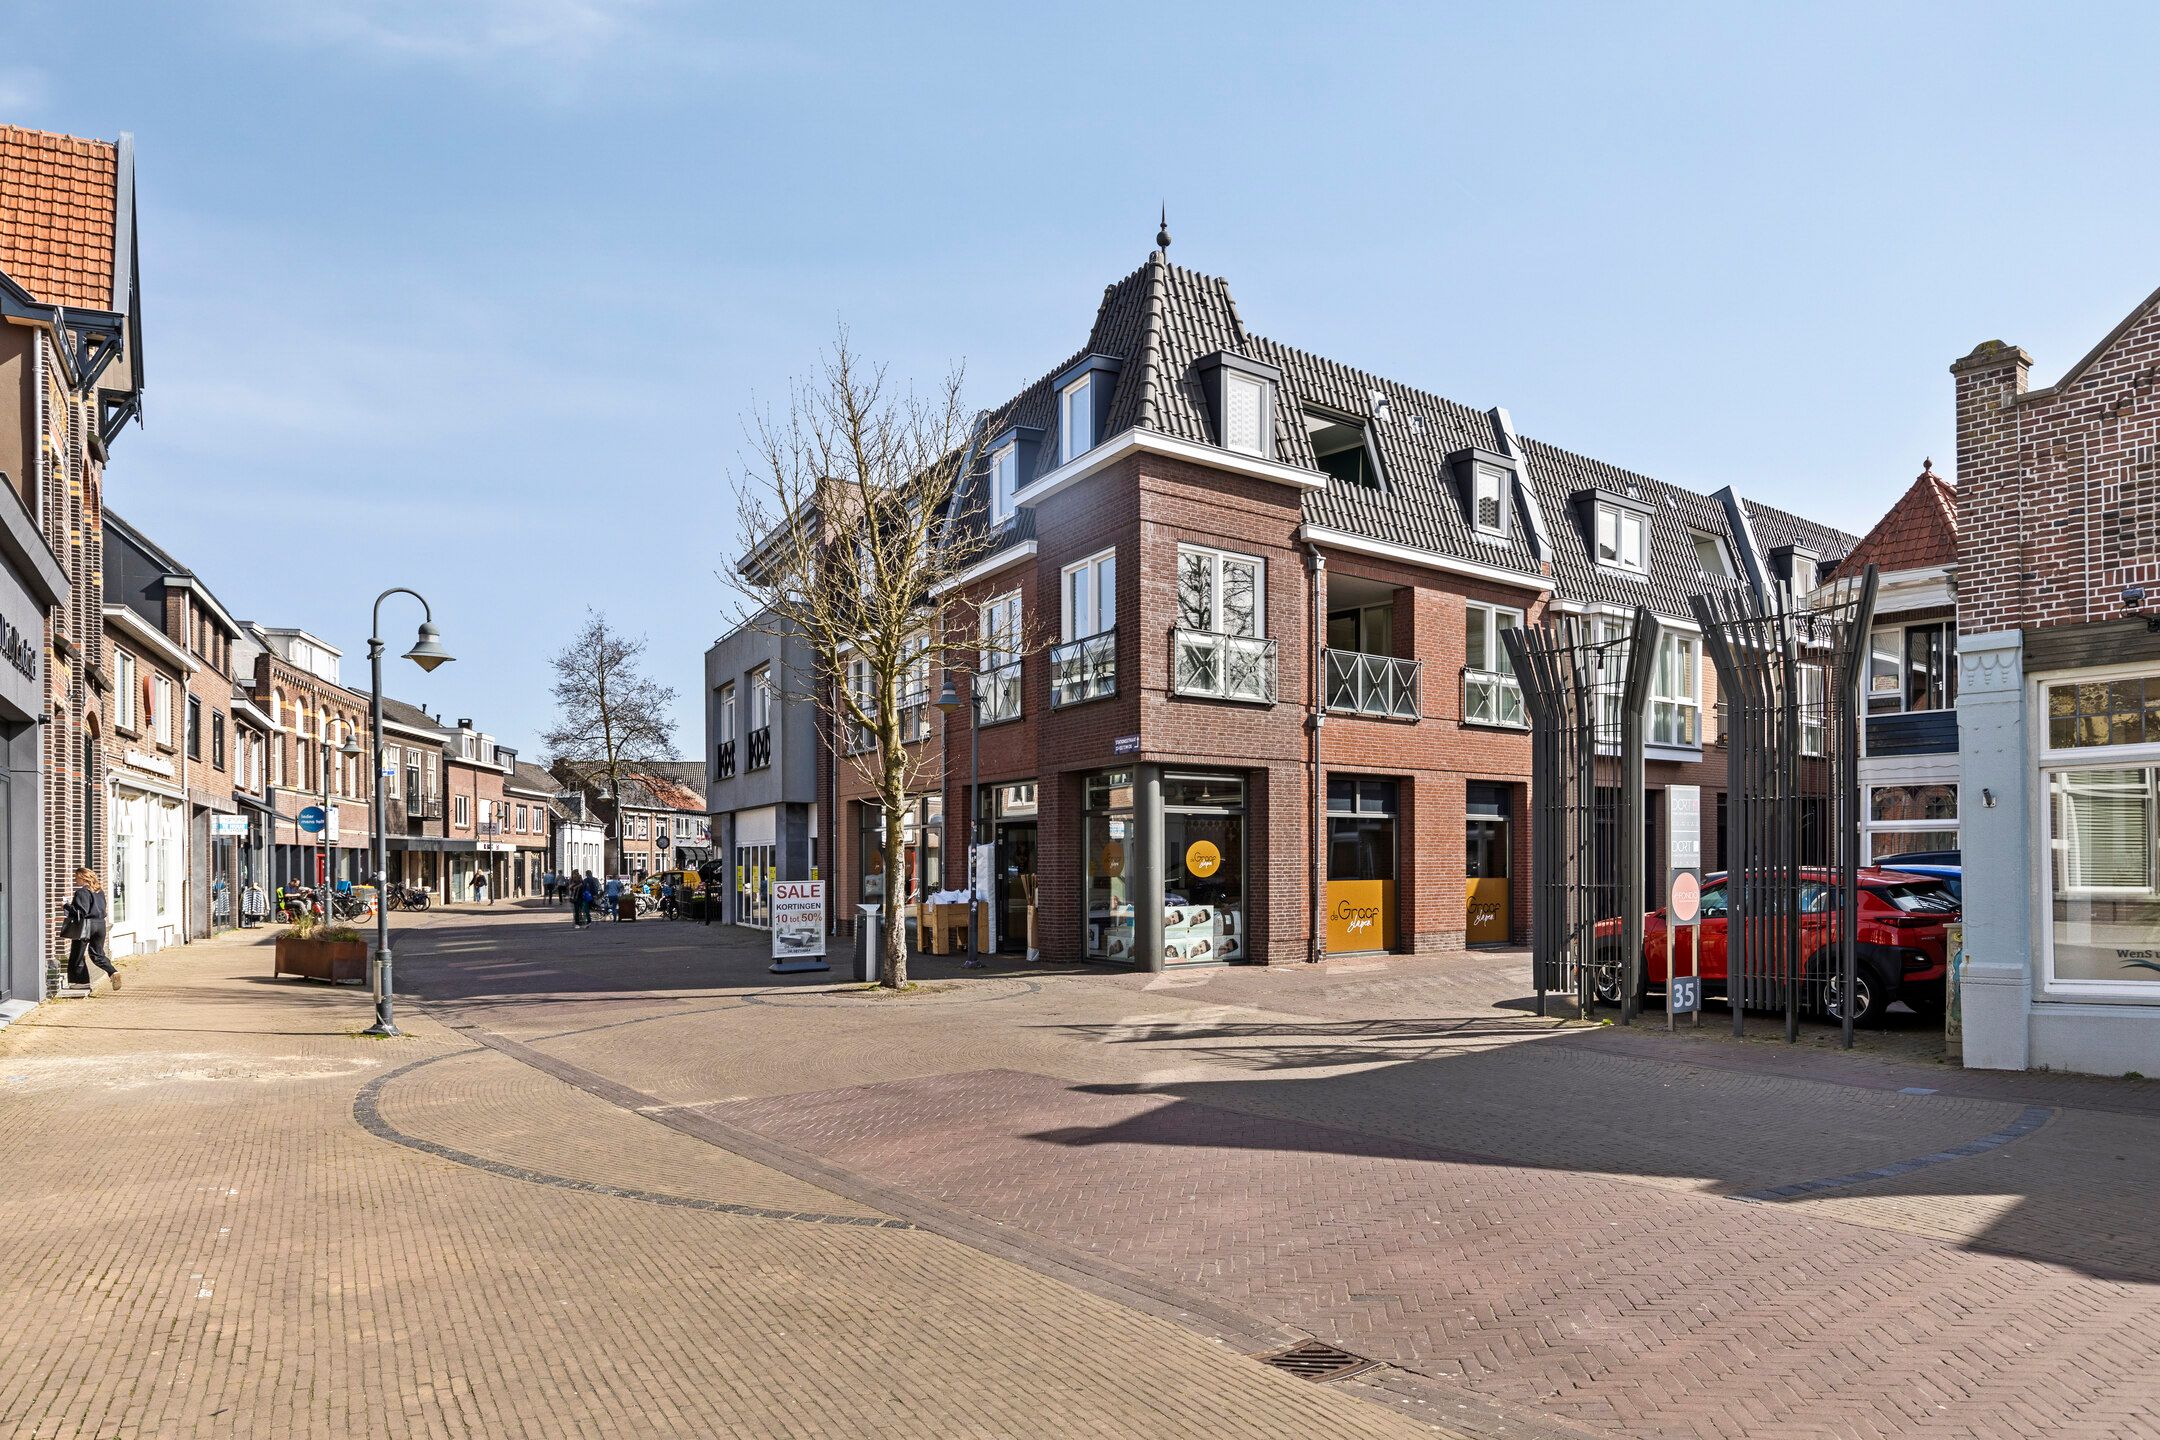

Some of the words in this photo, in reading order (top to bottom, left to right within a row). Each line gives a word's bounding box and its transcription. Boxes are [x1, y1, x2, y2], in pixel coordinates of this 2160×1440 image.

[777, 884, 821, 899] SALE
[776, 903, 822, 911] KORTINGEN
[1330, 910, 1339, 922] de
[1338, 900, 1379, 926] Graaf
[775, 914, 788, 923] 10
[801, 912, 823, 922] 50%
[2116, 949, 2152, 958] WenS
[1673, 982, 1695, 1008] 35
